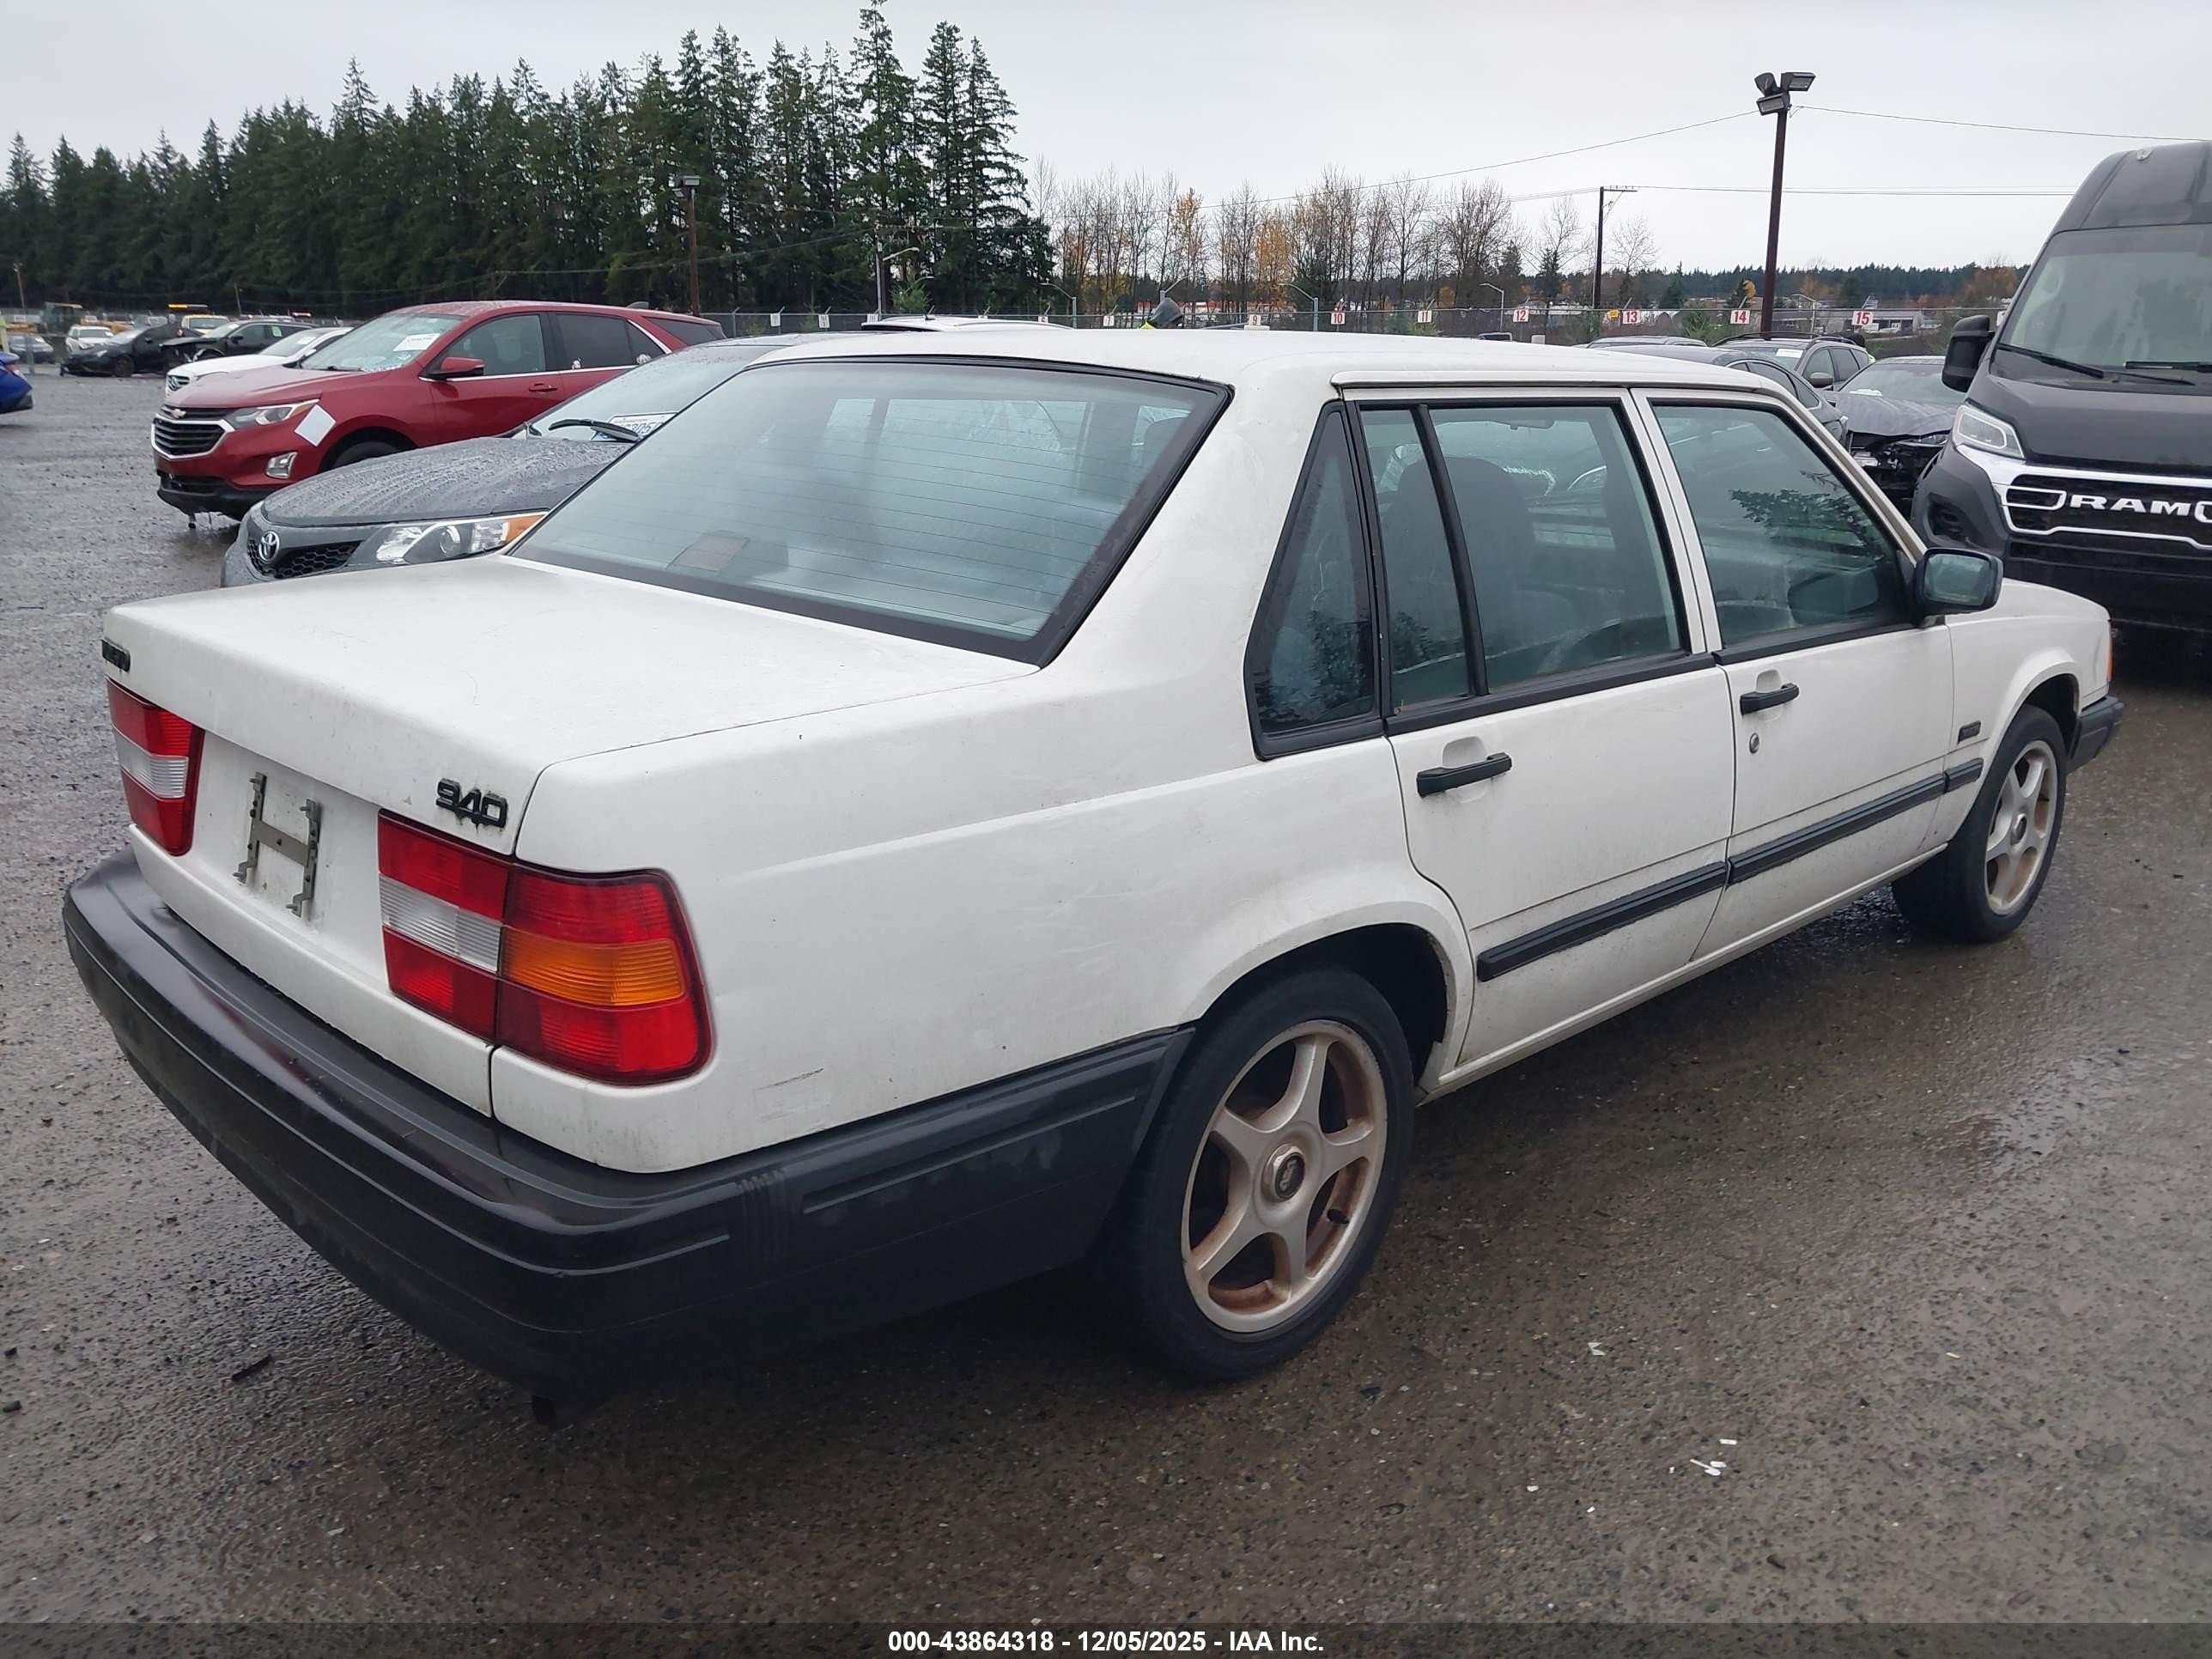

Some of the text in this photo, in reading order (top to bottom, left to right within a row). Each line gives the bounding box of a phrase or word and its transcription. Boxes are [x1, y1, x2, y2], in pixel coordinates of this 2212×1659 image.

[1252, 314, 1258, 325] 9
[1333, 313, 1343, 324] 10
[1421, 311, 1429, 322] 11
[1516, 309, 1527, 321] 12
[1626, 310, 1638, 323] 13
[1735, 310, 1747, 324] 14
[1856, 312, 1870, 325] 15
[2069, 495, 2192, 516] RAM
[435, 778, 508, 829] 940
